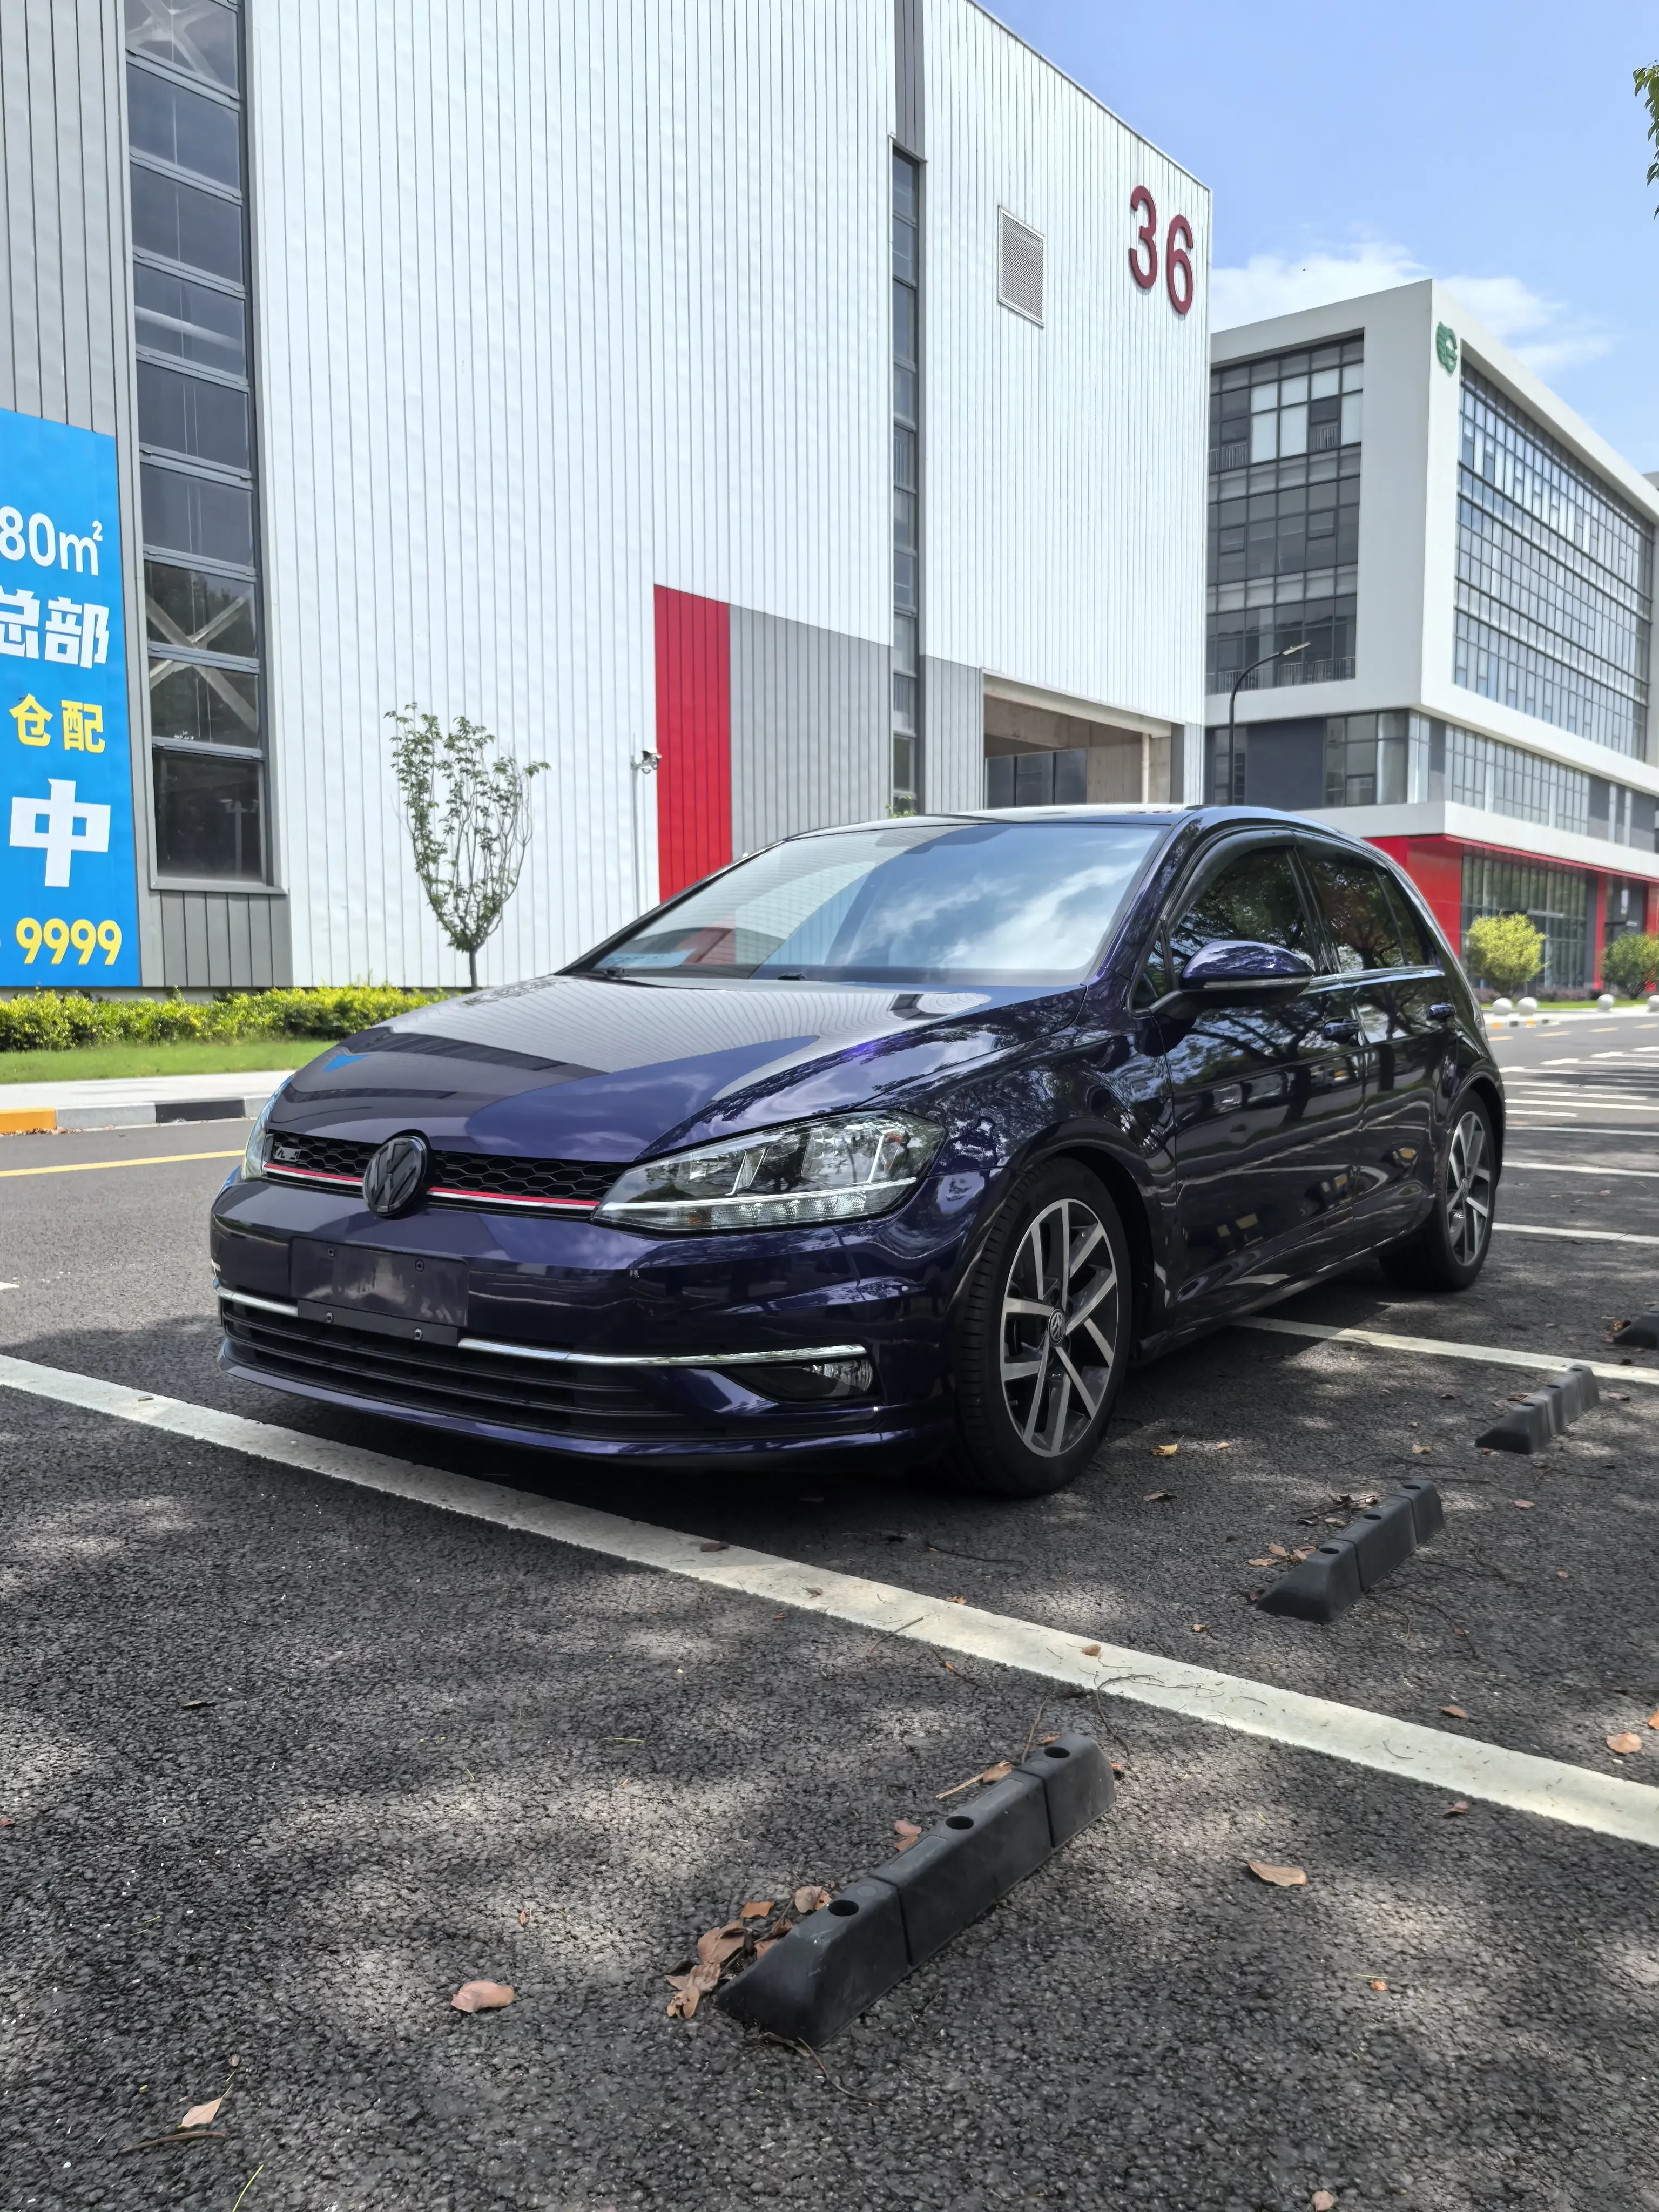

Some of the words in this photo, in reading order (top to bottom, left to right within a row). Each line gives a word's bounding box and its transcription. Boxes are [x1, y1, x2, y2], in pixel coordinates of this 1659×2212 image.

[1128, 185, 1193, 314] 36
[0, 585, 109, 669] 总部
[9, 693, 105, 753] 仓配
[9, 778, 111, 887] 中
[16, 917, 122, 965] 9999
